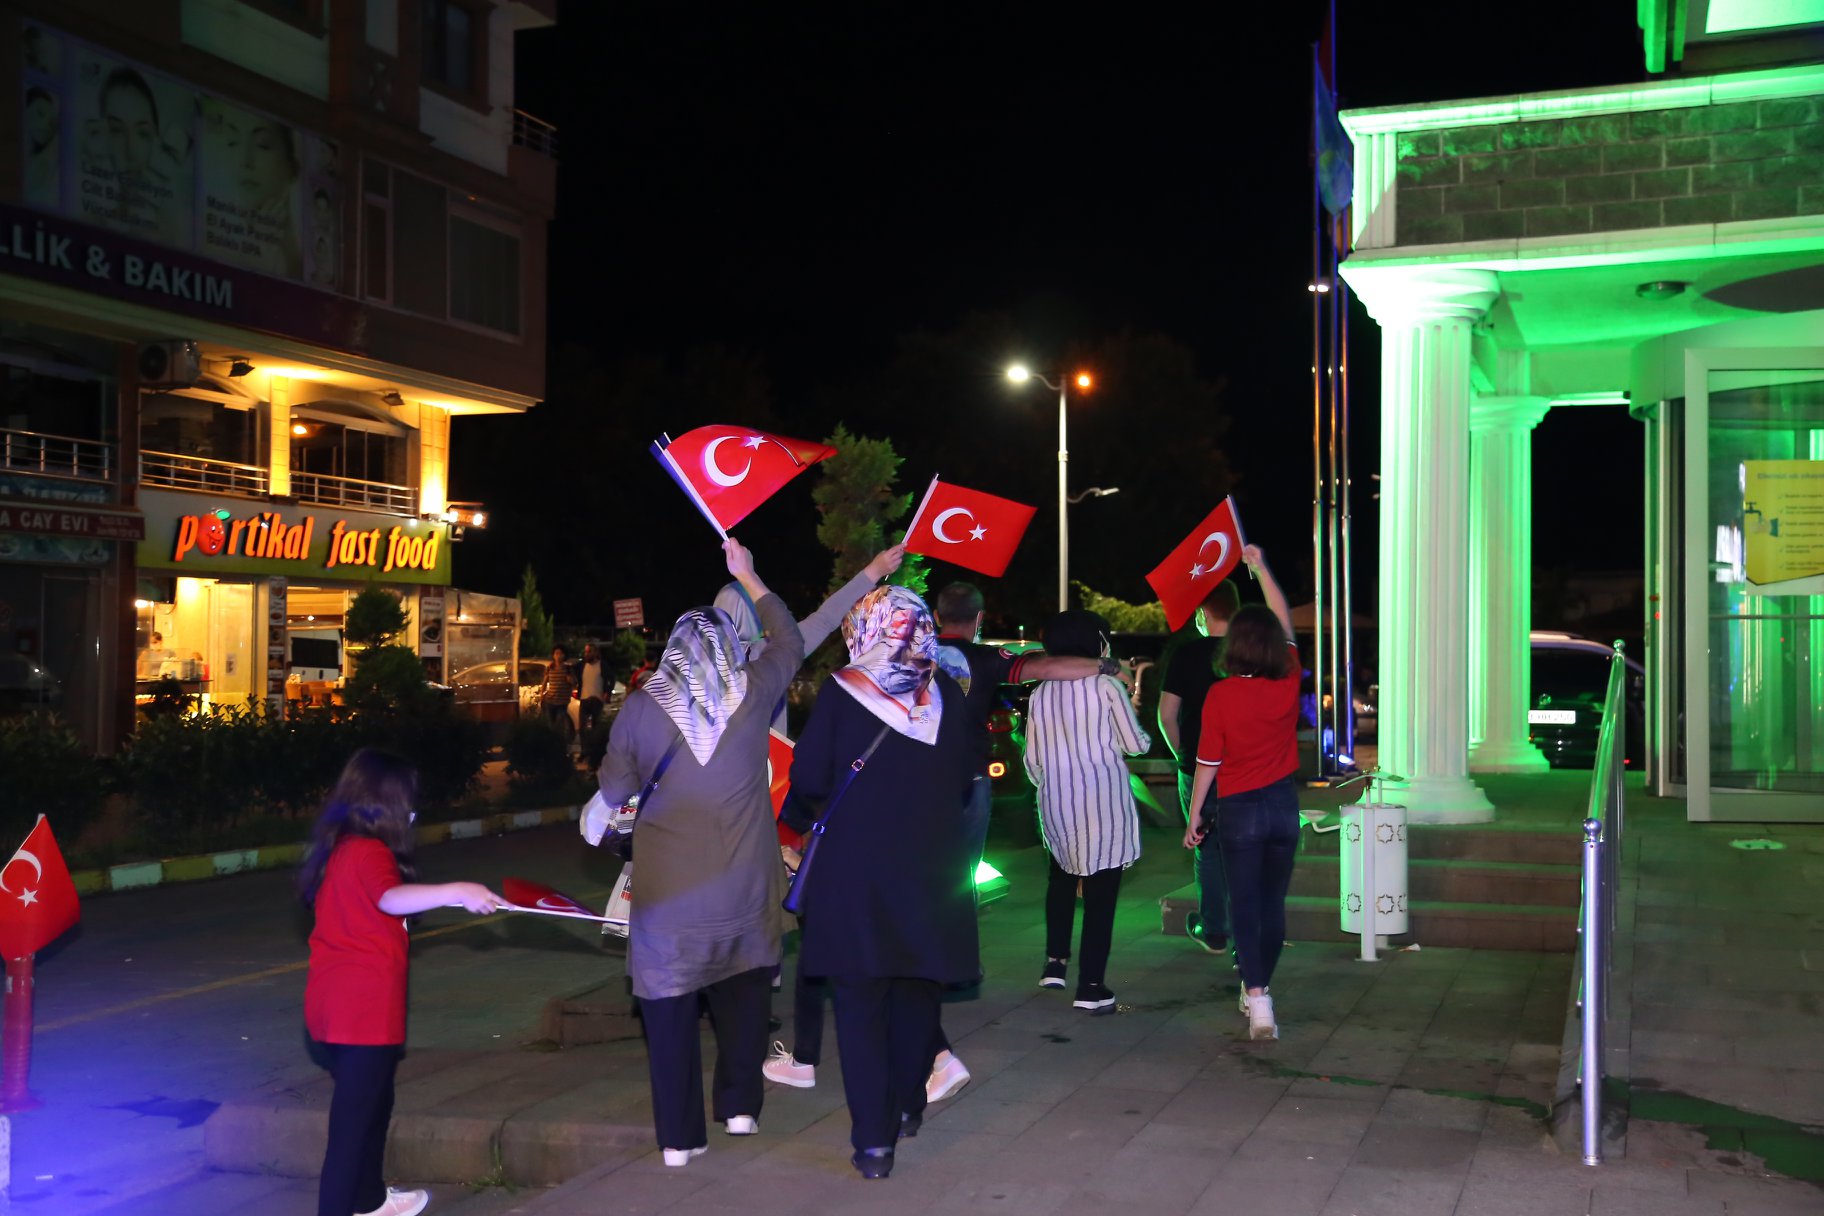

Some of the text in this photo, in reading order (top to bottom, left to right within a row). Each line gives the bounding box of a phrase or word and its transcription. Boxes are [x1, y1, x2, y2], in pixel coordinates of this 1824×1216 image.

[85, 244, 111, 279] &
[124, 254, 233, 309] BAKIM
[327, 519, 382, 568] fast
[383, 525, 440, 573] food
